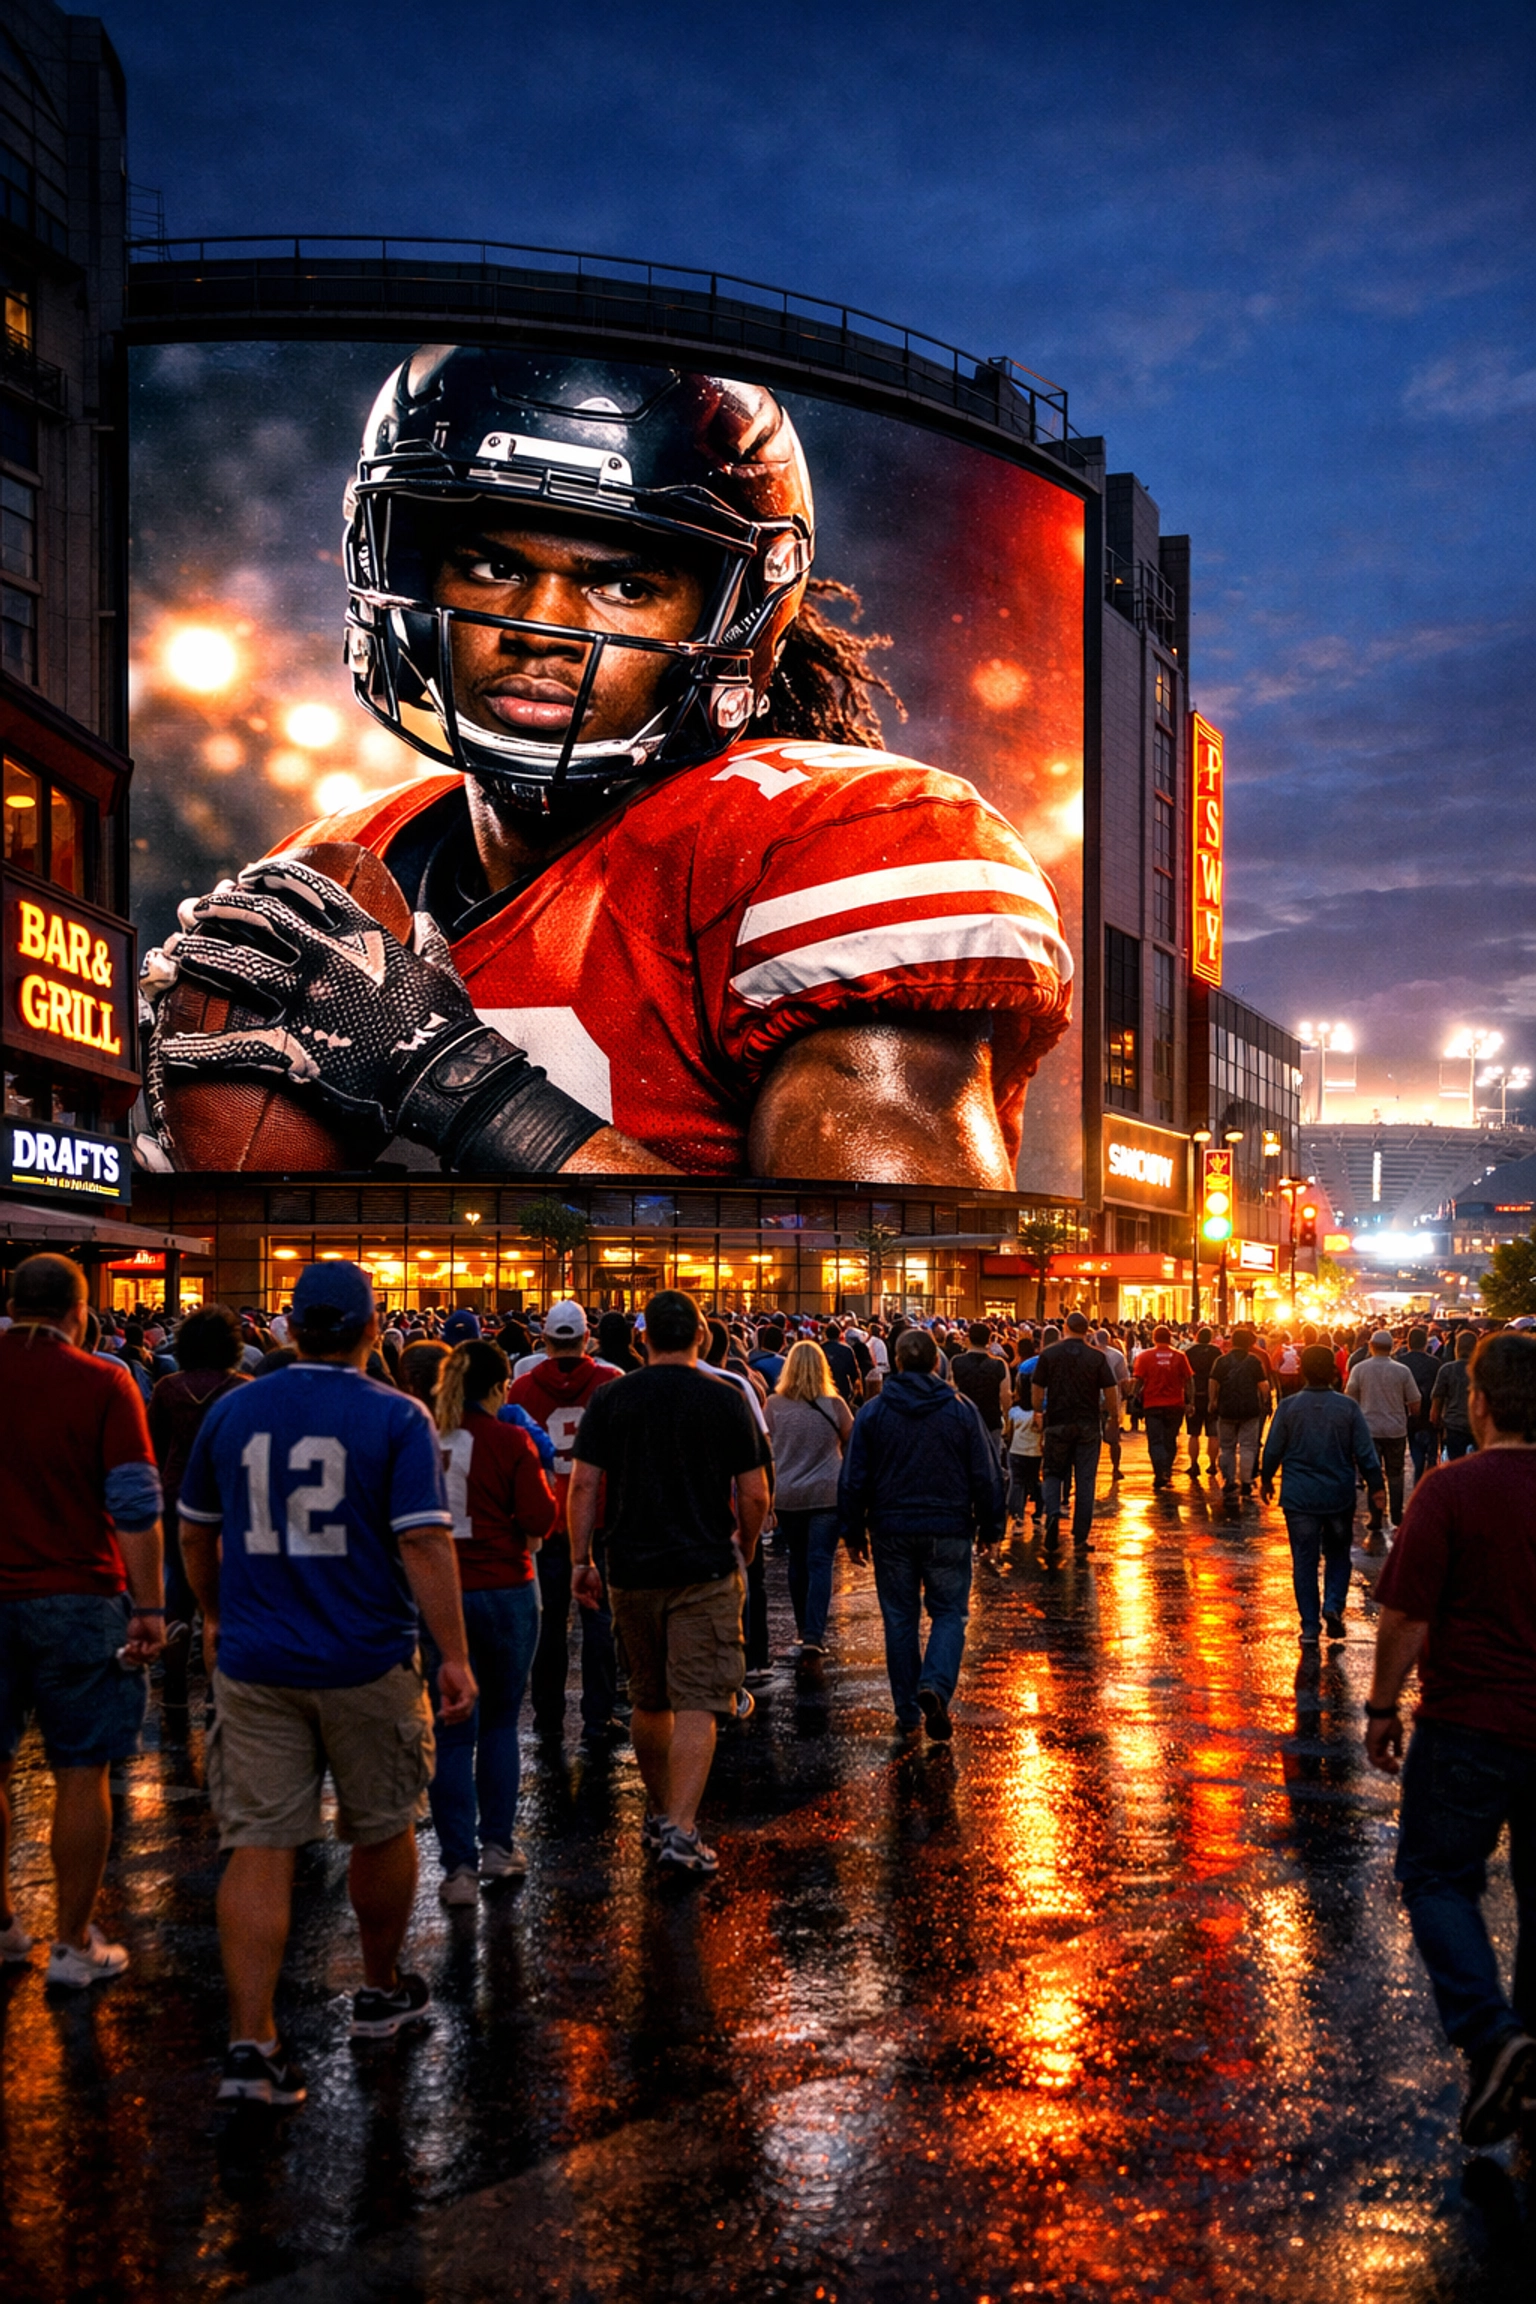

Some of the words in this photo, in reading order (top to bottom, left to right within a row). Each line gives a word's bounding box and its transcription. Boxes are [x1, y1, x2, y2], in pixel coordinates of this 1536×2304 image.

[18, 900, 113, 988] BAR&
[21, 974, 121, 1056] GRILL
[12, 1129, 120, 1183] DRAFTS
[241, 1432, 348, 1556] 12
